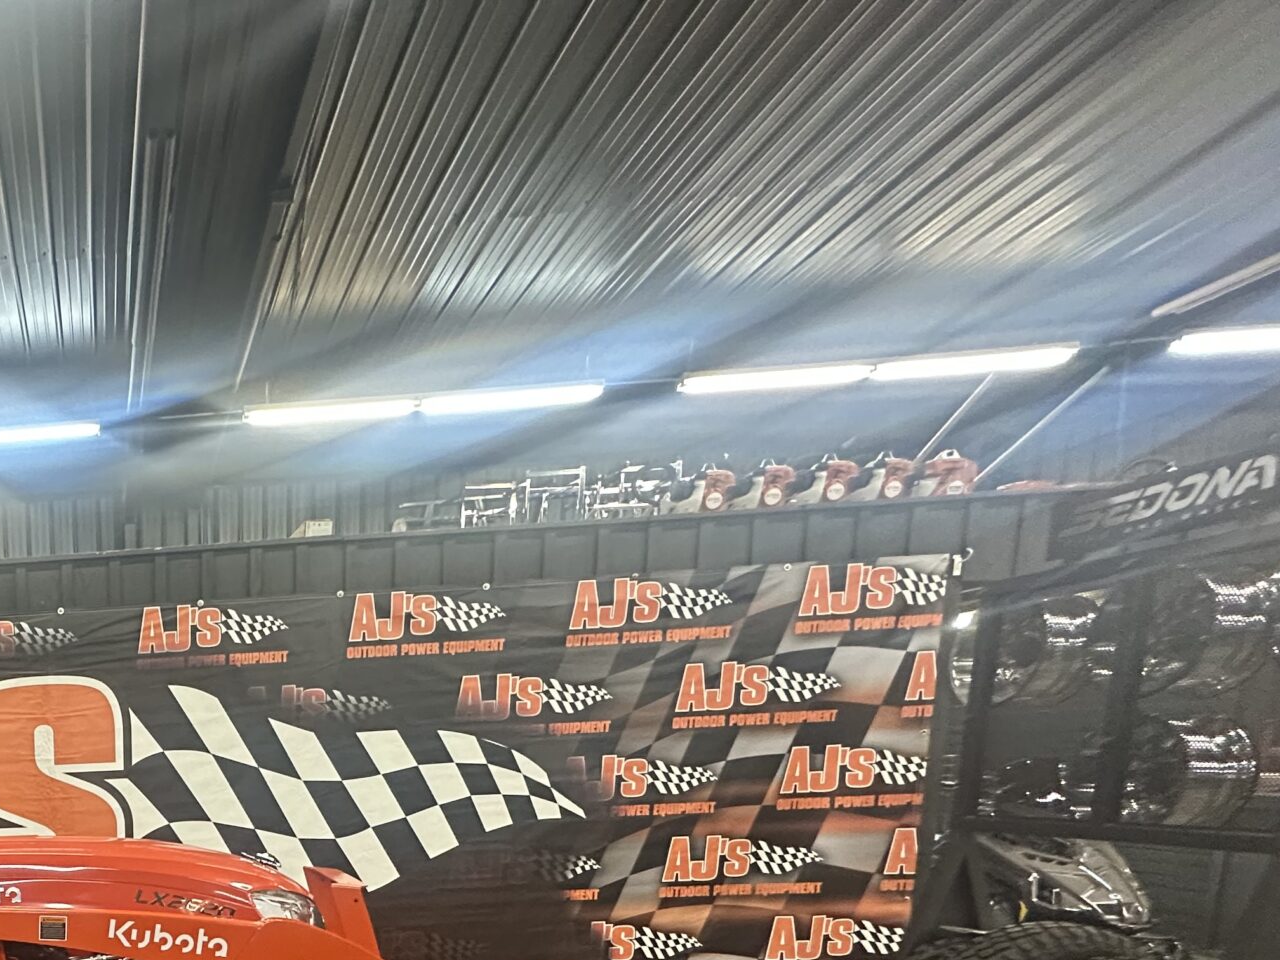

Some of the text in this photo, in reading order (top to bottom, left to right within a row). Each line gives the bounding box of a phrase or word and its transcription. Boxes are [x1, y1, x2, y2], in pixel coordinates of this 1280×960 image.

[1058, 454, 1277, 538] SEDONA
[569, 577, 662, 630] AJ'S
[798, 562, 897, 617] AJ'S
[138, 604, 221, 654] AJ'S
[348, 591, 438, 642] AJ'S
[565, 625, 732, 648] OUTDOOR POWER EQUIPMENT
[229, 650, 289, 668] EQUIPMENT
[346, 638, 506, 660] OUTDOOR POWER EQUIPMENT
[456, 673, 544, 720] AJ'S
[675, 661, 769, 713] AJ'S
[548, 720, 612, 736] EQUIPMENT
[672, 709, 838, 730] OUTDOOR POWER EQUIPMENT
[780, 744, 876, 795] AJ'S
[653, 801, 716, 817] EQUIPMENT
[662, 835, 752, 883] AJ'S
[713, 883, 752, 897] POWER
[108, 918, 229, 957] Kubota
[765, 914, 855, 960] AJ'S
